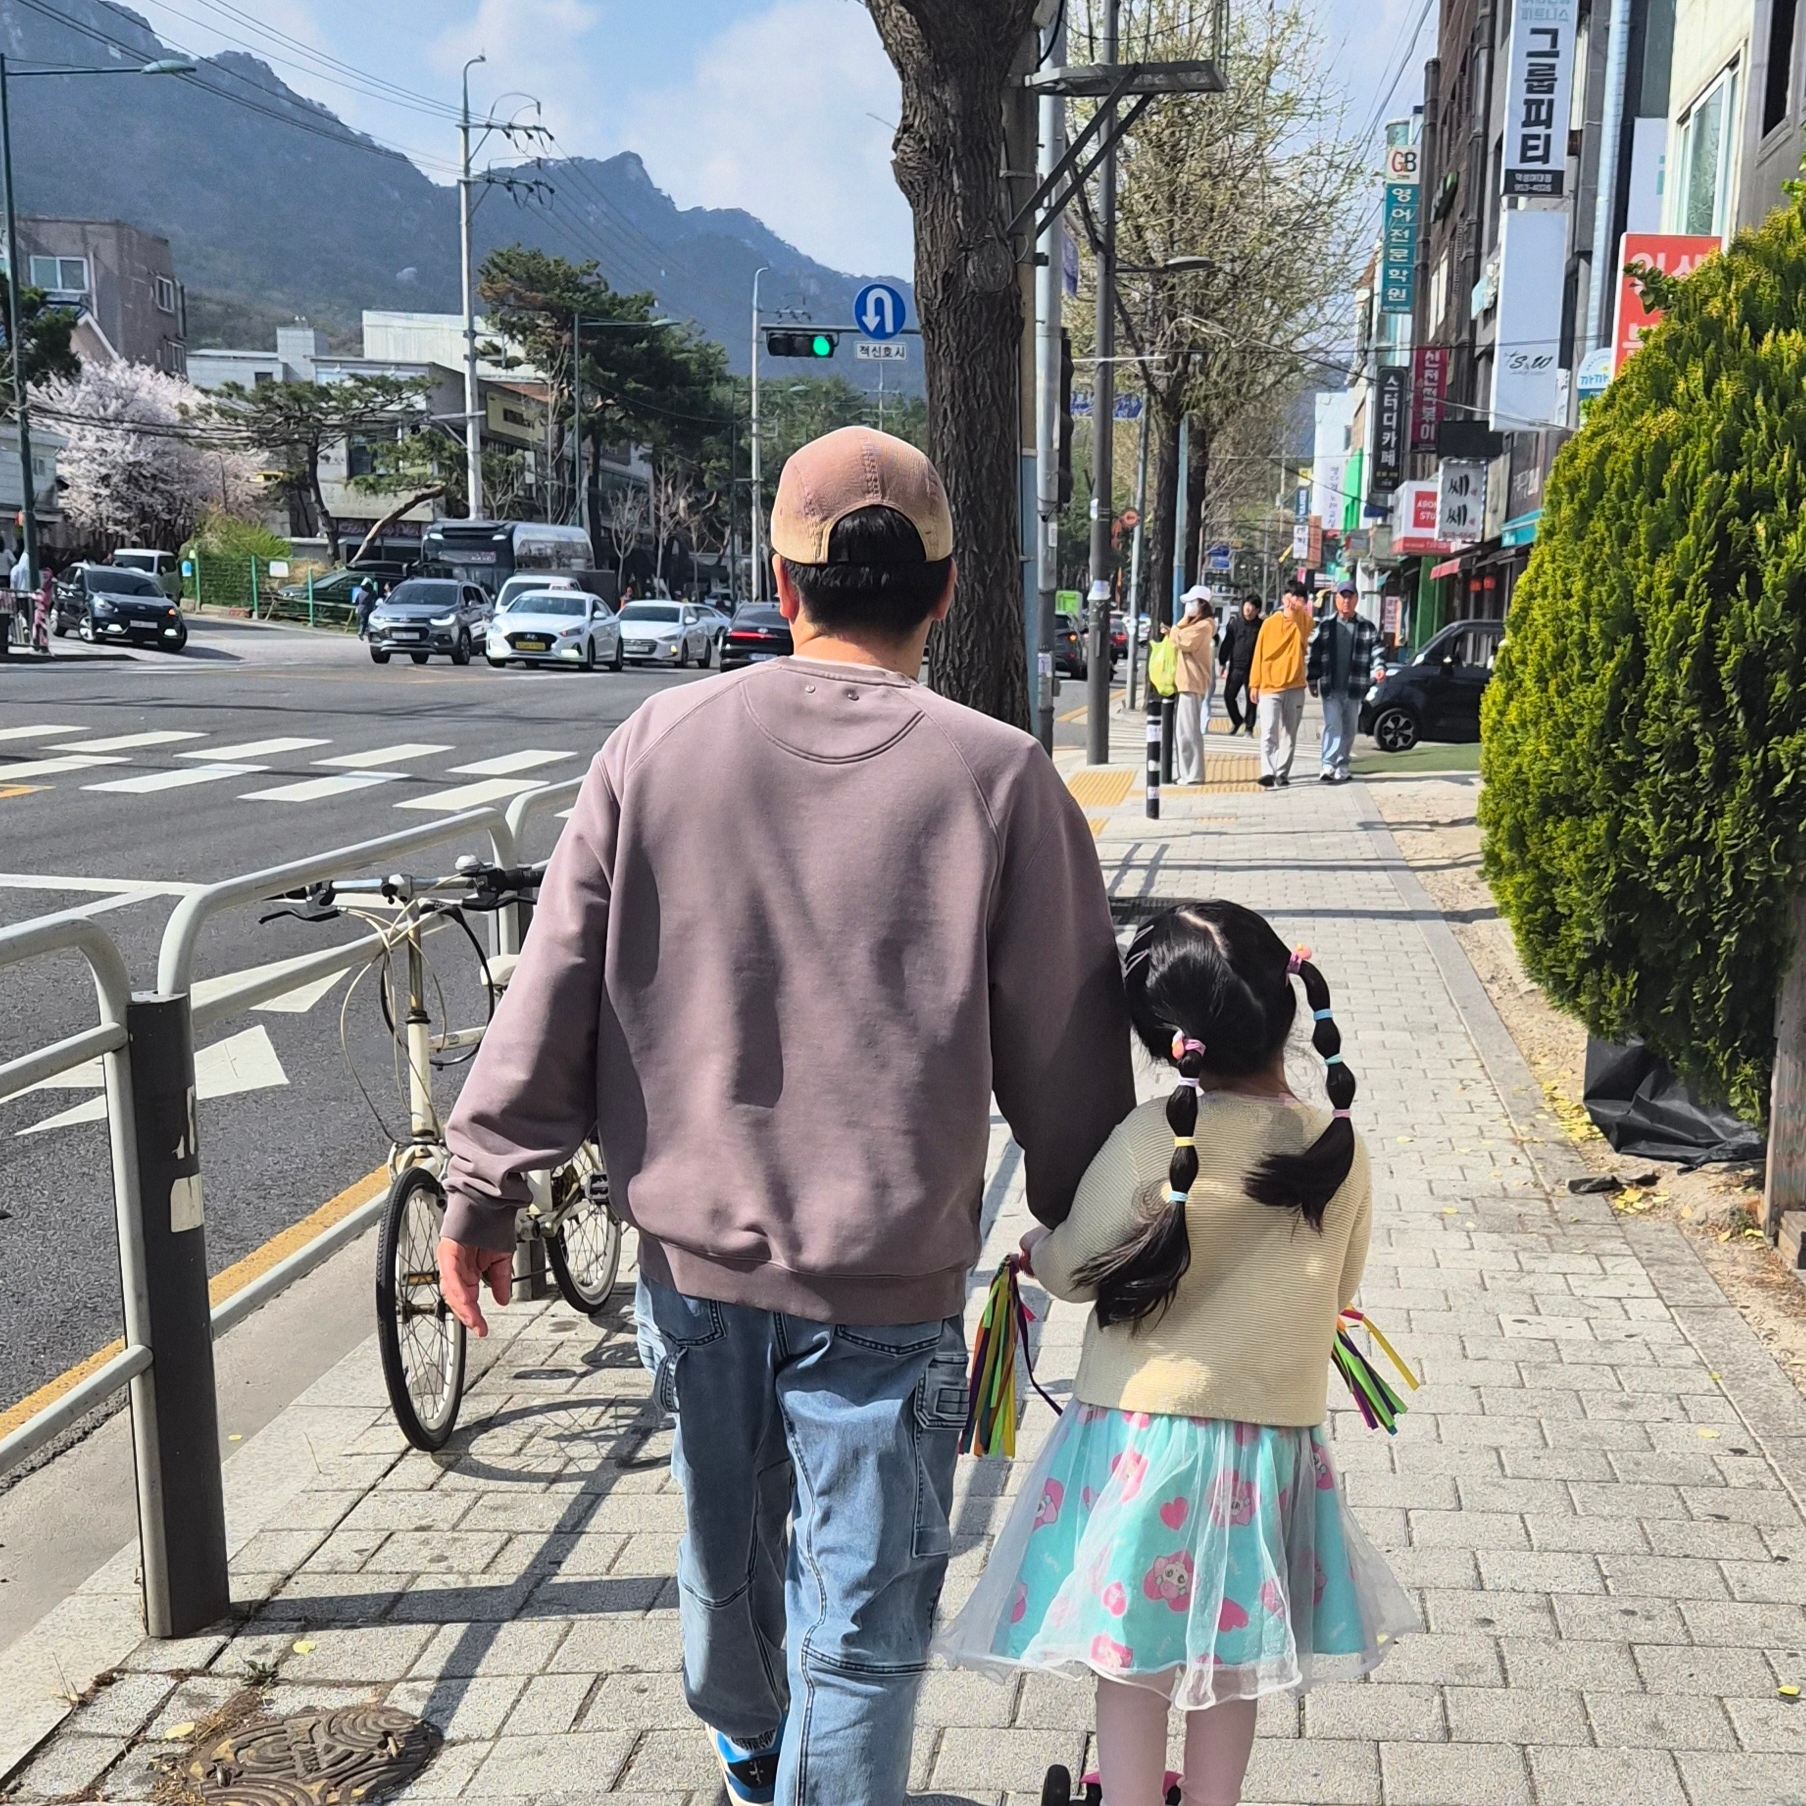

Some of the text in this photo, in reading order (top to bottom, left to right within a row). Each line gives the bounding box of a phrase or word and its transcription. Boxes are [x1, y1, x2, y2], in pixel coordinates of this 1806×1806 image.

[1521, 7, 1569, 21] 피트니스
[1519, 28, 1560, 165] 그룹피티
[1391, 151, 1417, 172] GB
[1387, 188, 1413, 302] 영어전문학원
[859, 345, 905, 358] 적신호시
[1381, 375, 1400, 467] 스터디카페
